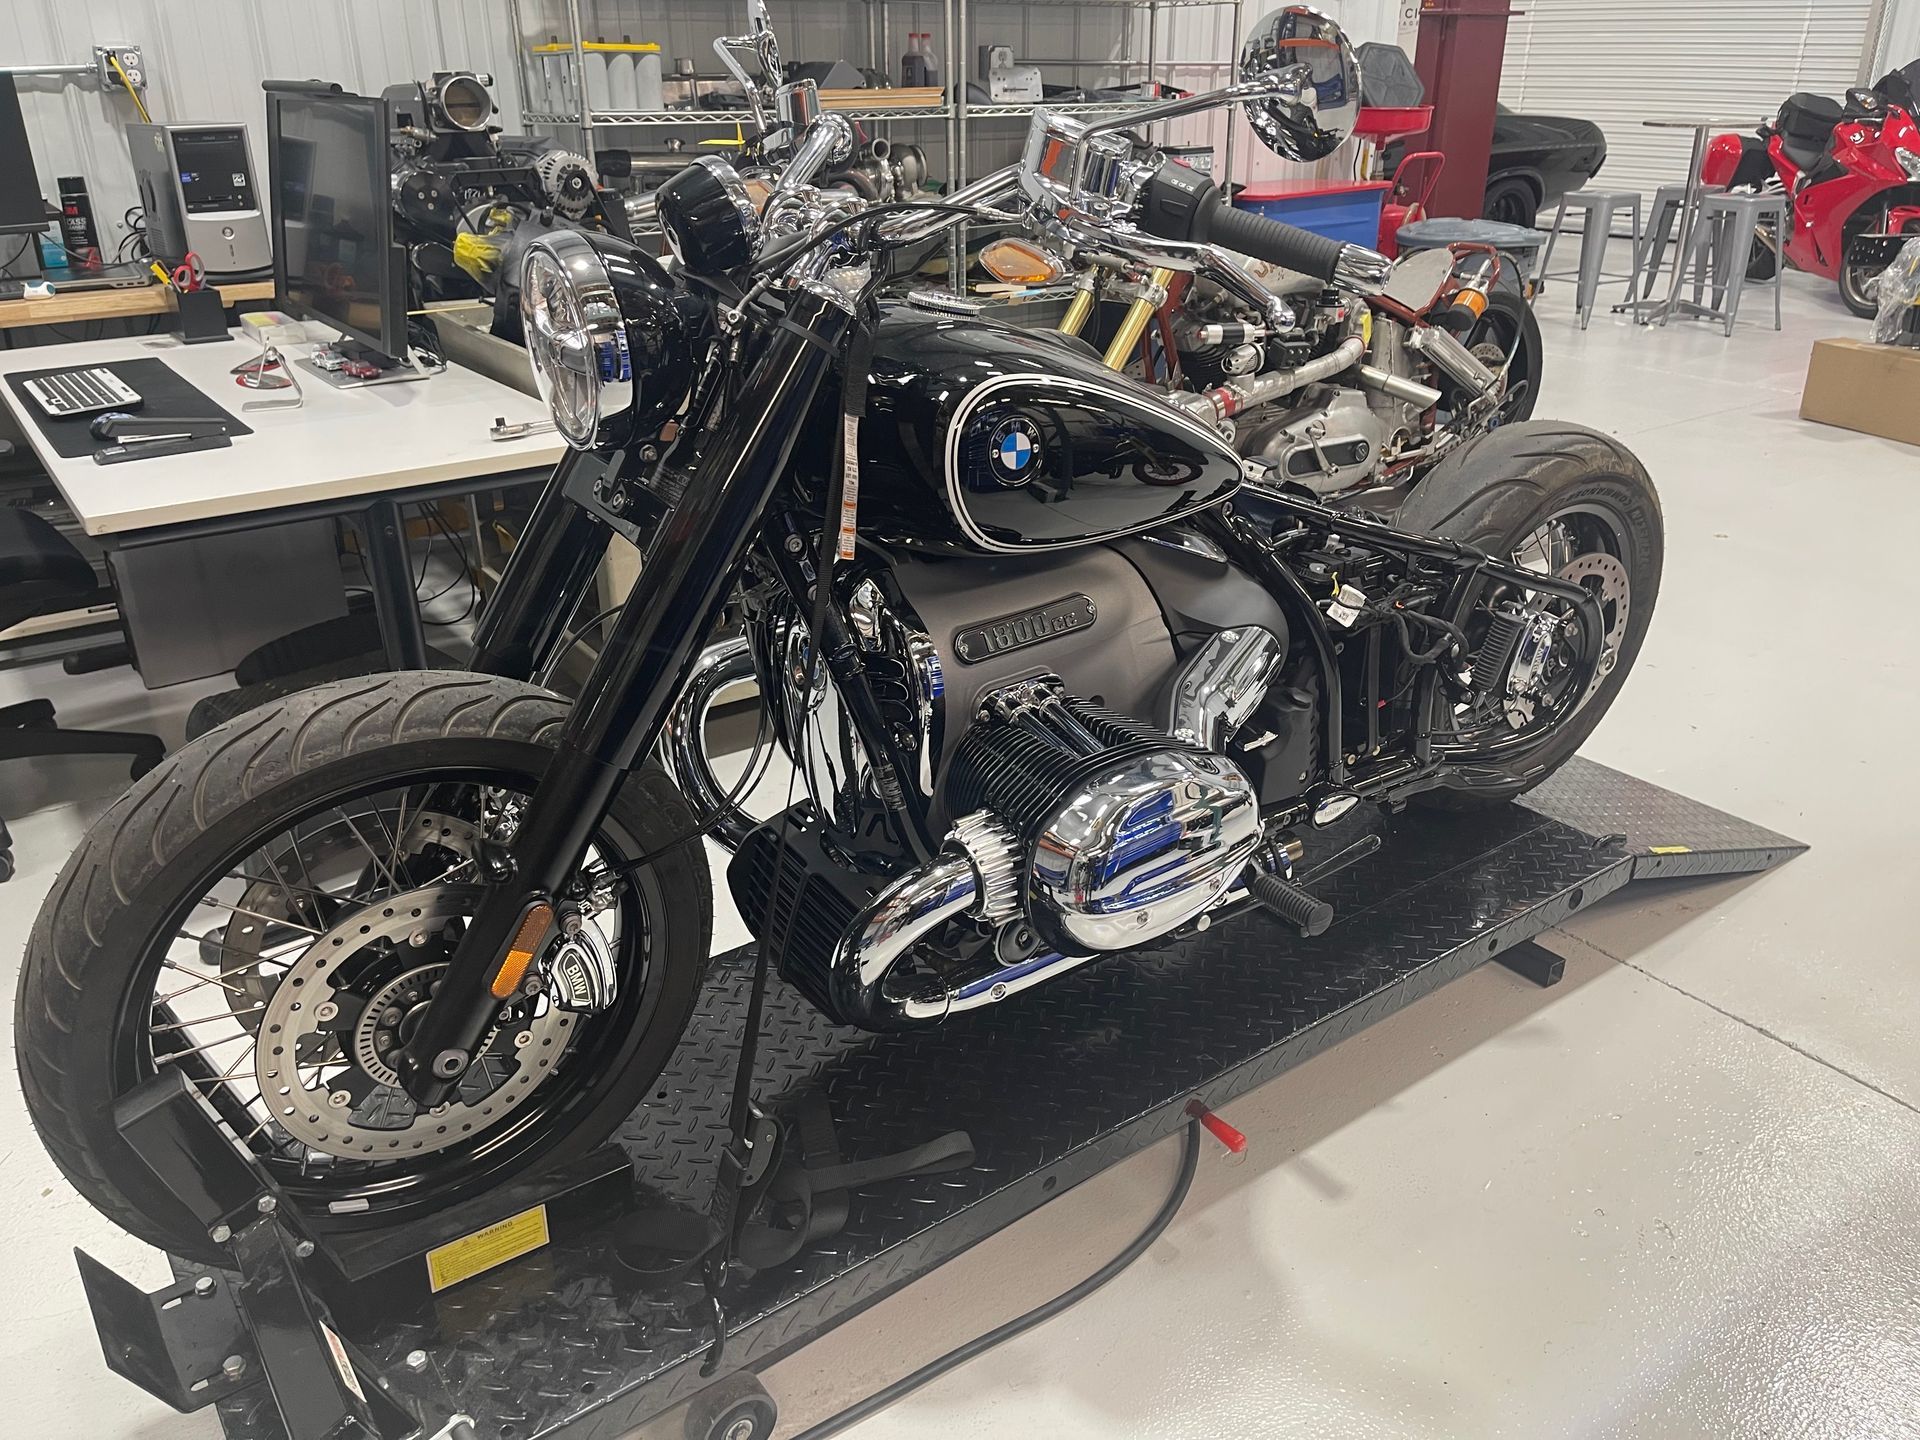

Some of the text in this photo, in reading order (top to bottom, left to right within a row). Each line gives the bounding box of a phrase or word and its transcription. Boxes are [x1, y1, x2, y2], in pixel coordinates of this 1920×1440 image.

[995, 421, 1037, 443] BMW
[566, 963, 587, 995] BMW
[477, 1221, 513, 1240] WARNING
